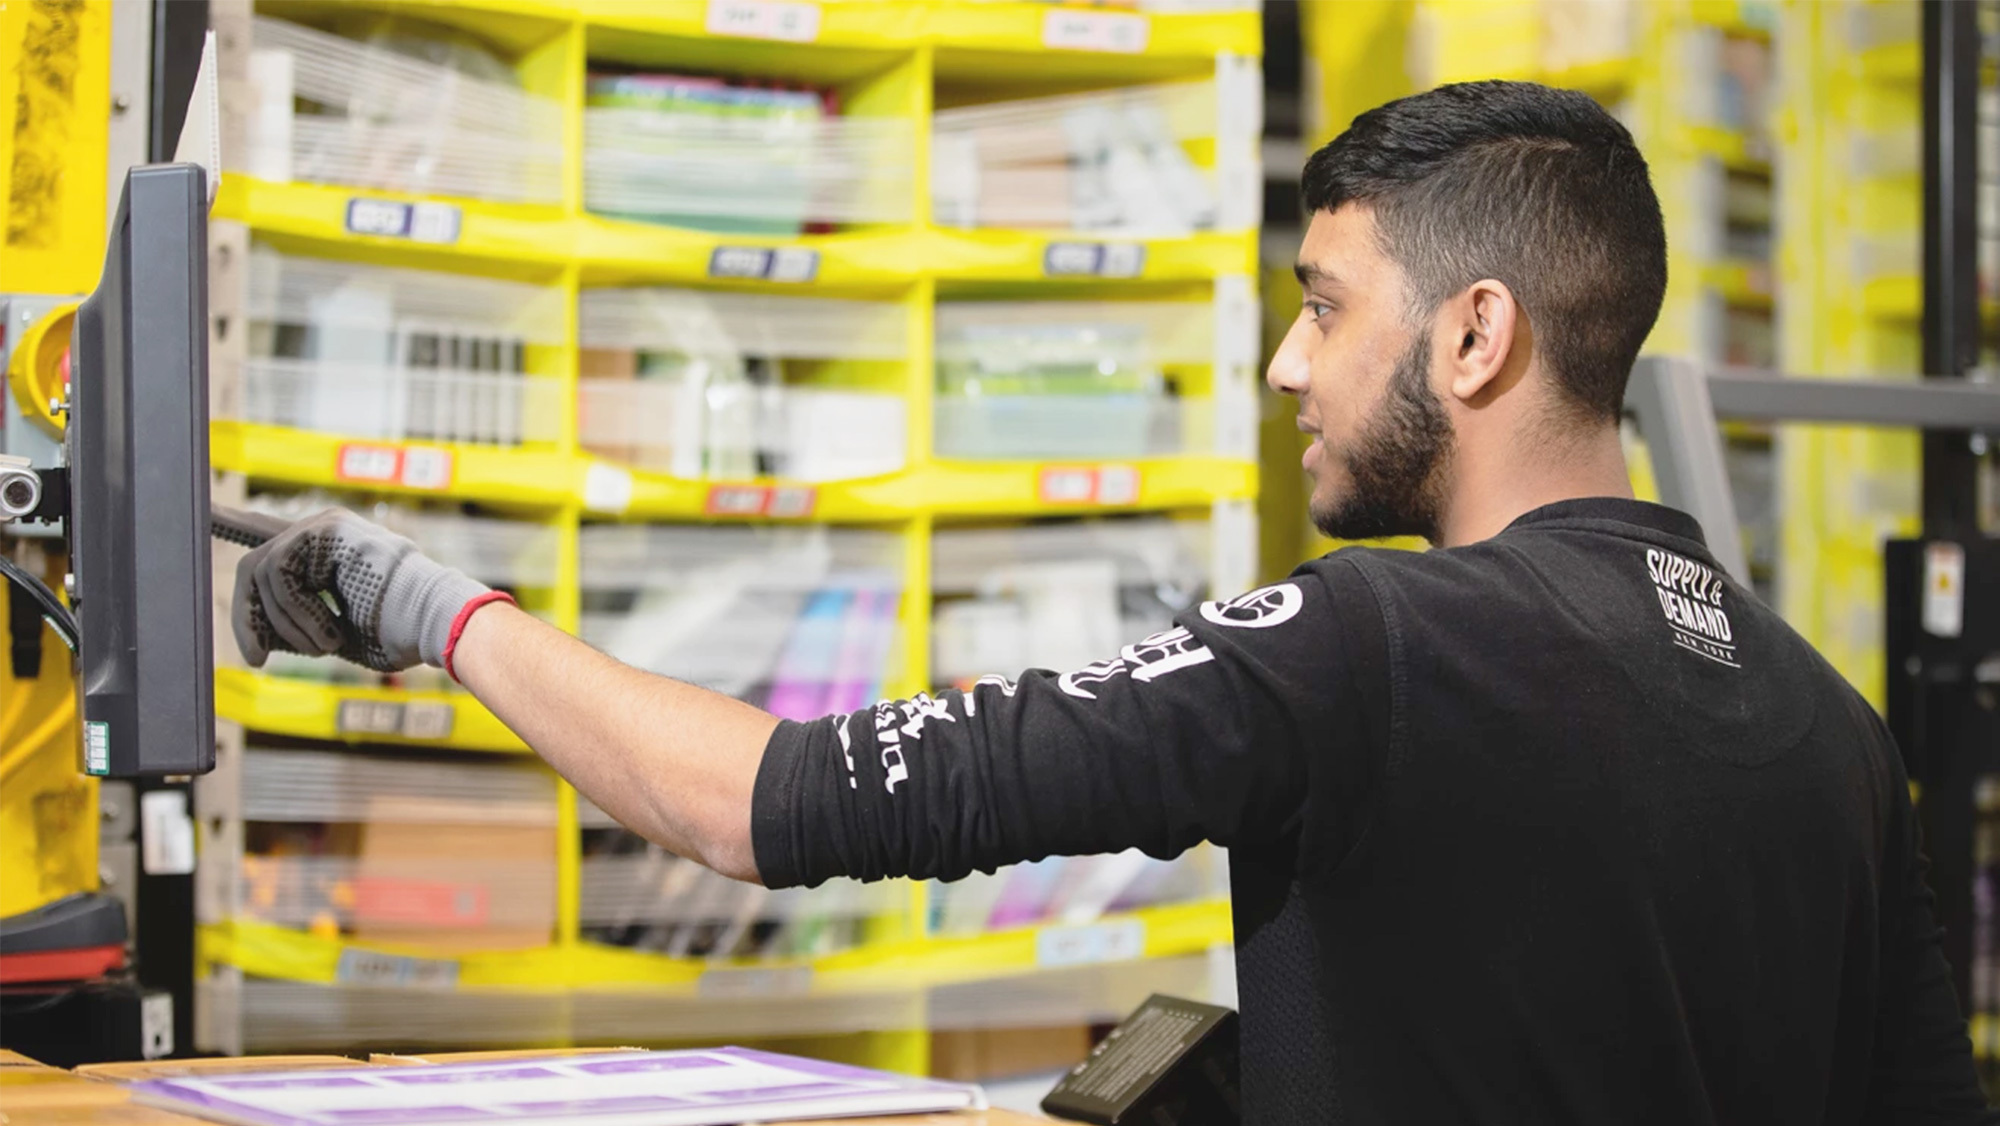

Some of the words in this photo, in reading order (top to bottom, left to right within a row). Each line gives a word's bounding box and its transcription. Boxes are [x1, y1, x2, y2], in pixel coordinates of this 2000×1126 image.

[1646, 548, 1713, 602] SUPPLY
[1710, 579, 1723, 607] &
[1655, 585, 1732, 642] DEMAND
